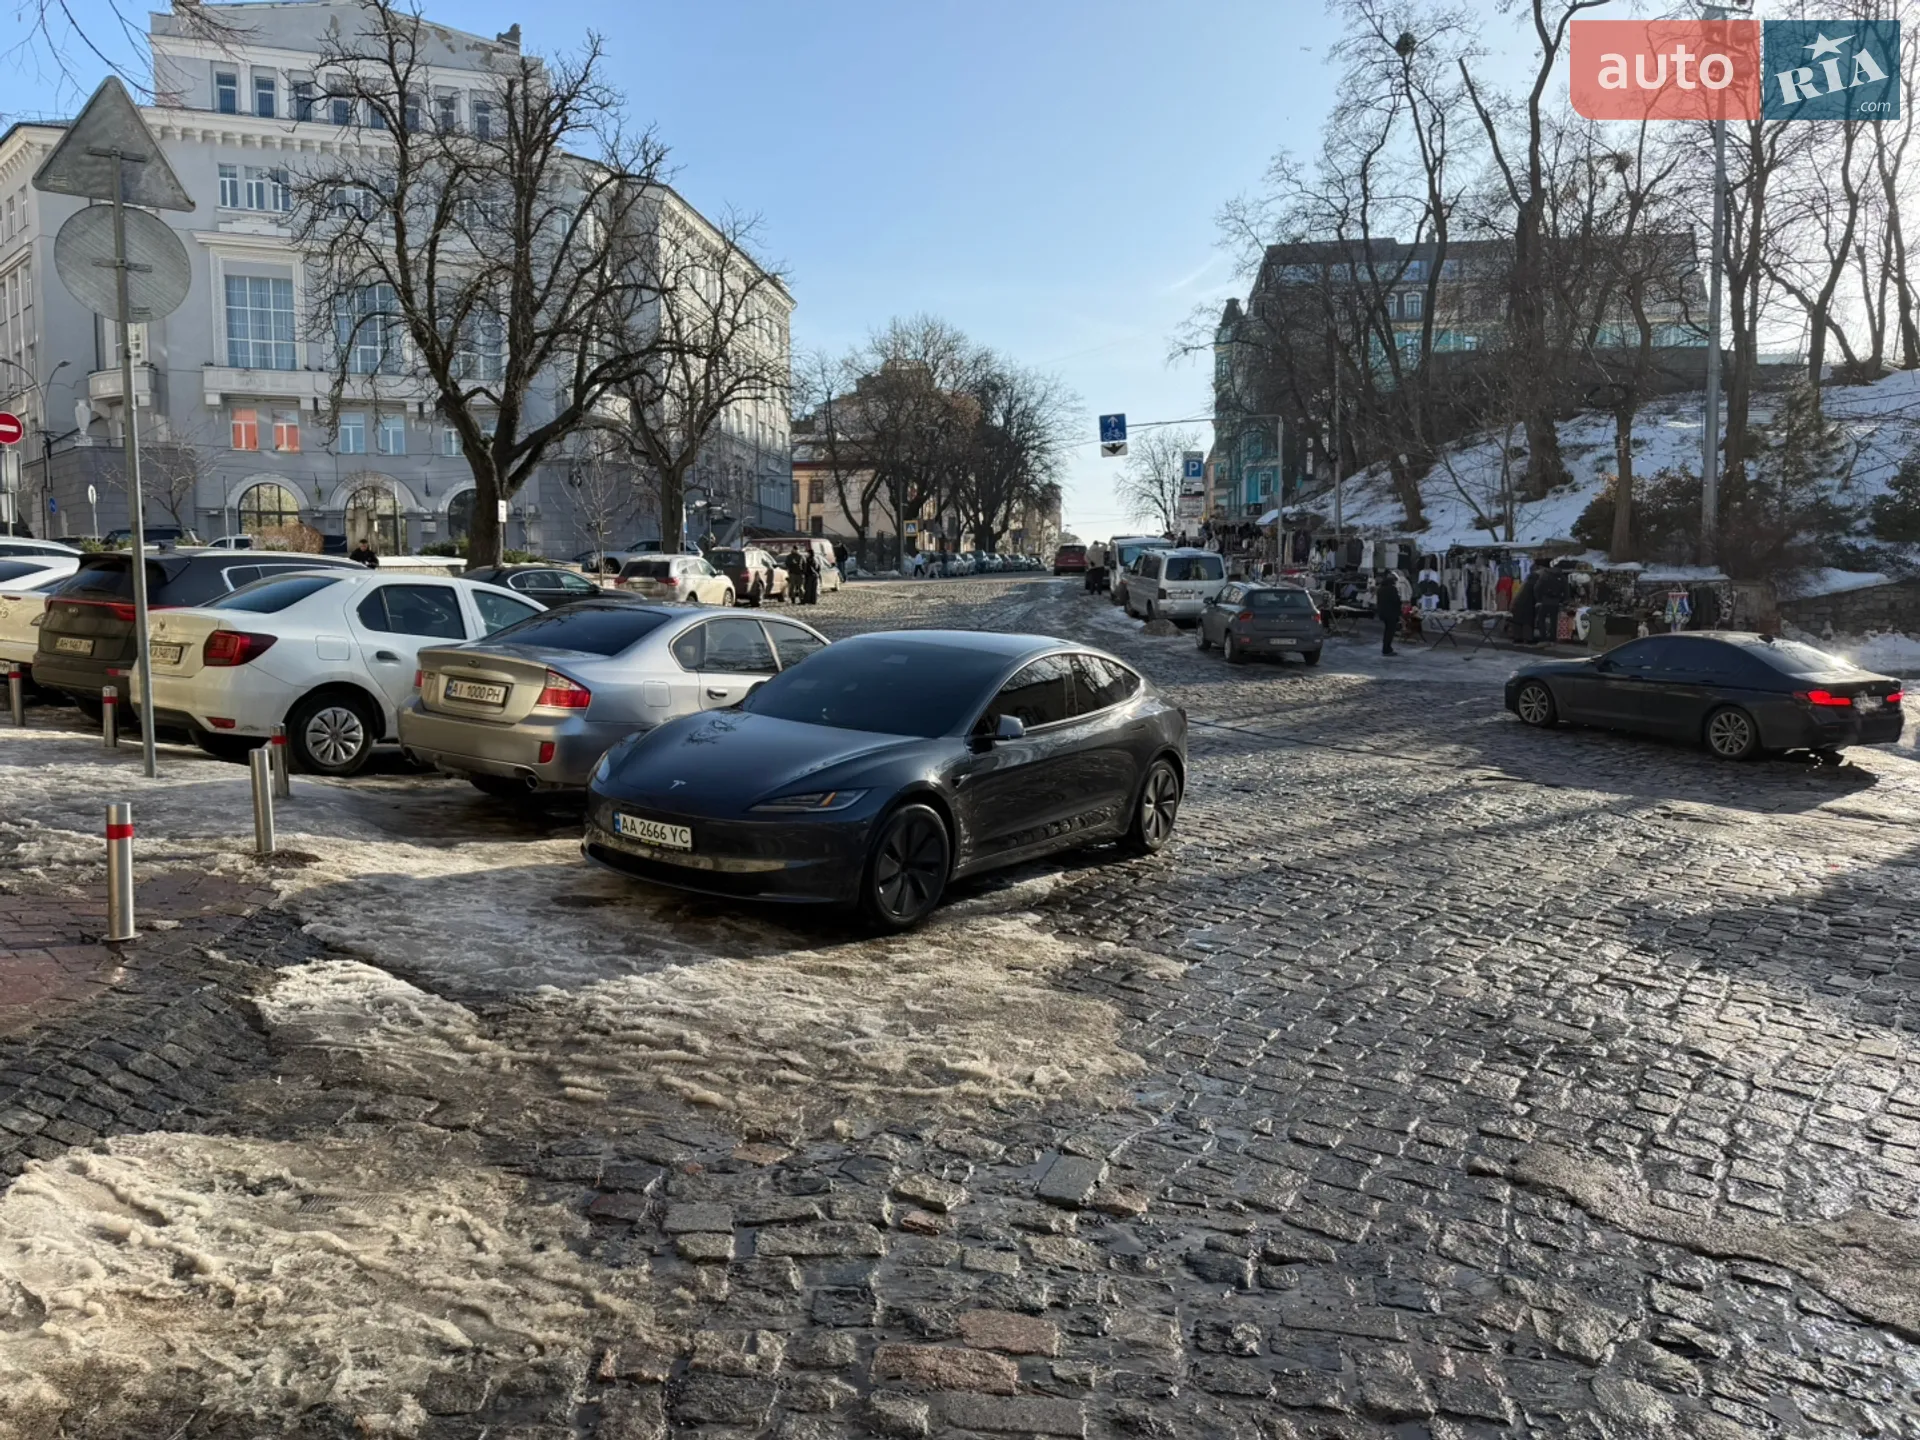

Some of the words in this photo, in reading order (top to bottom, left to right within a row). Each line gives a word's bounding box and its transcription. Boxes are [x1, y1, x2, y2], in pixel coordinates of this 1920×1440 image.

[1189, 461, 1199, 476] P
[451, 682, 463, 695] AI
[466, 685, 486, 700] 1000
[486, 687, 501, 701] PH
[621, 817, 638, 835] AA
[639, 821, 667, 842] 2666
[669, 826, 689, 844] YC
